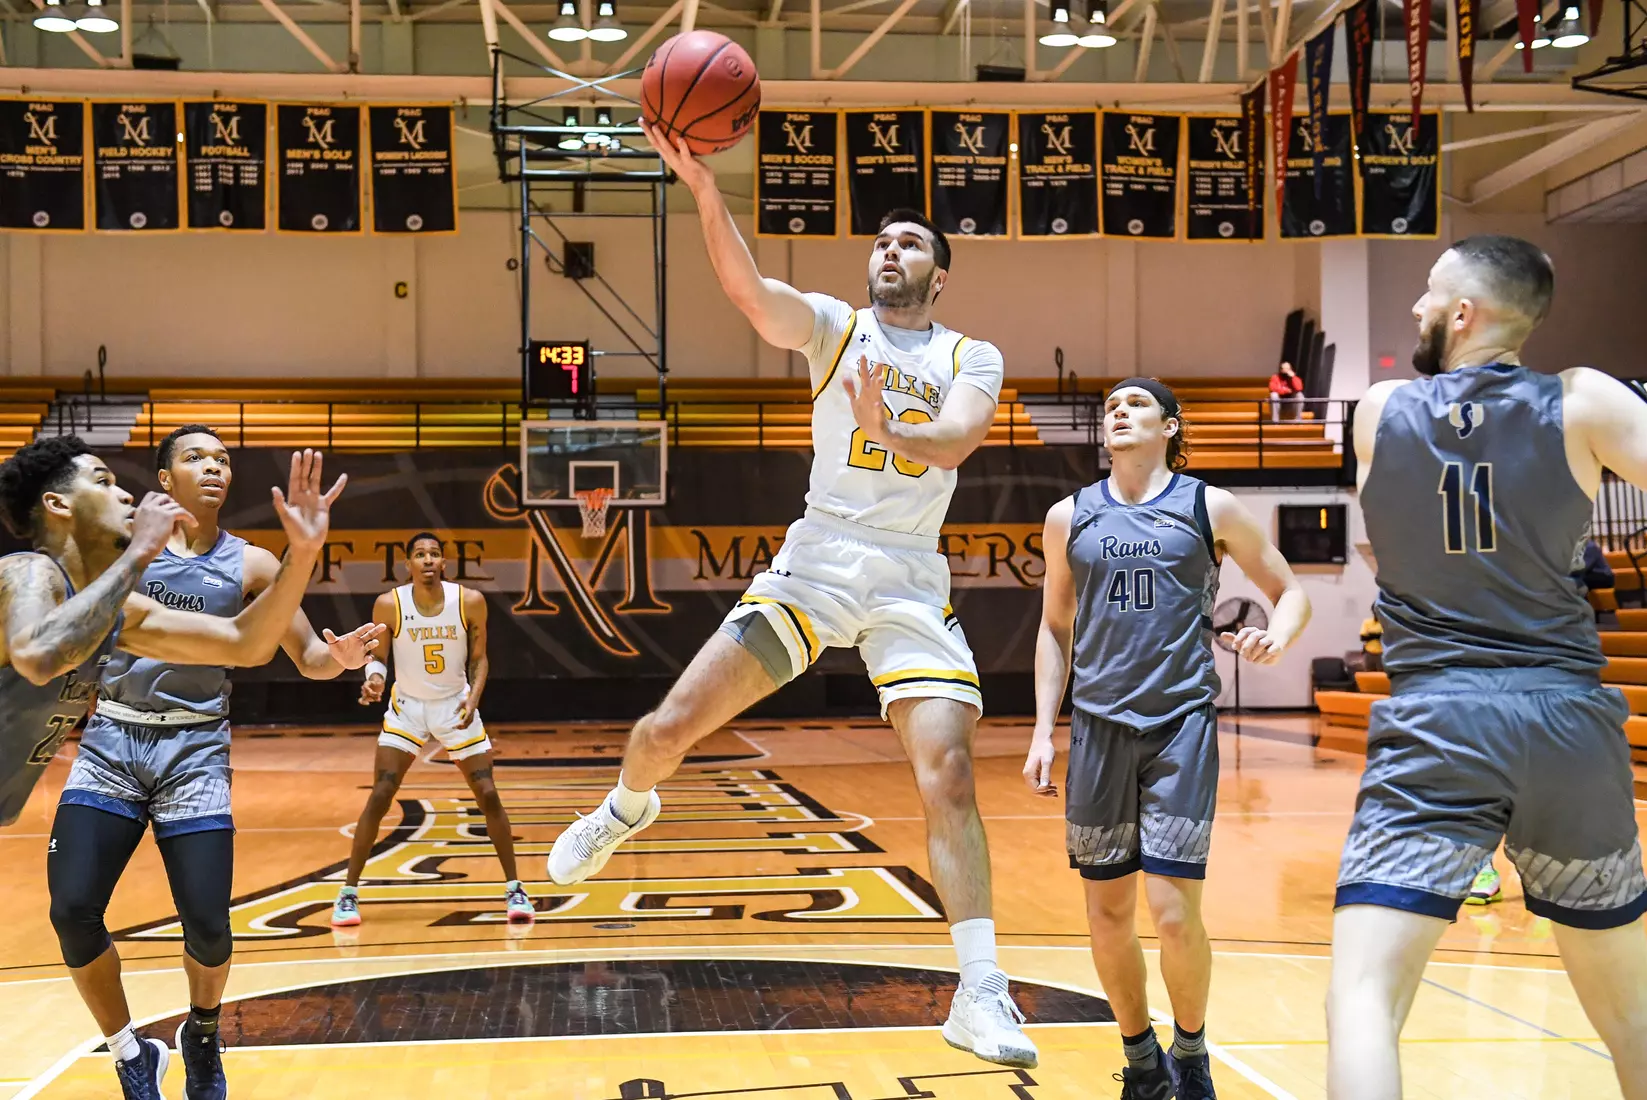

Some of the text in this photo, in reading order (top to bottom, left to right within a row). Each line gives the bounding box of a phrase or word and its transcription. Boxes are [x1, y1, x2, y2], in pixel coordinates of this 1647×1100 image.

[540, 346, 584, 365] 14:33
[1437, 461, 1497, 554] 11
[1100, 535, 1162, 560] Rams
[146, 580, 206, 612] Rams
[1106, 567, 1155, 612] 40
[407, 625, 458, 642] VILLE
[423, 644, 445, 674] 5
